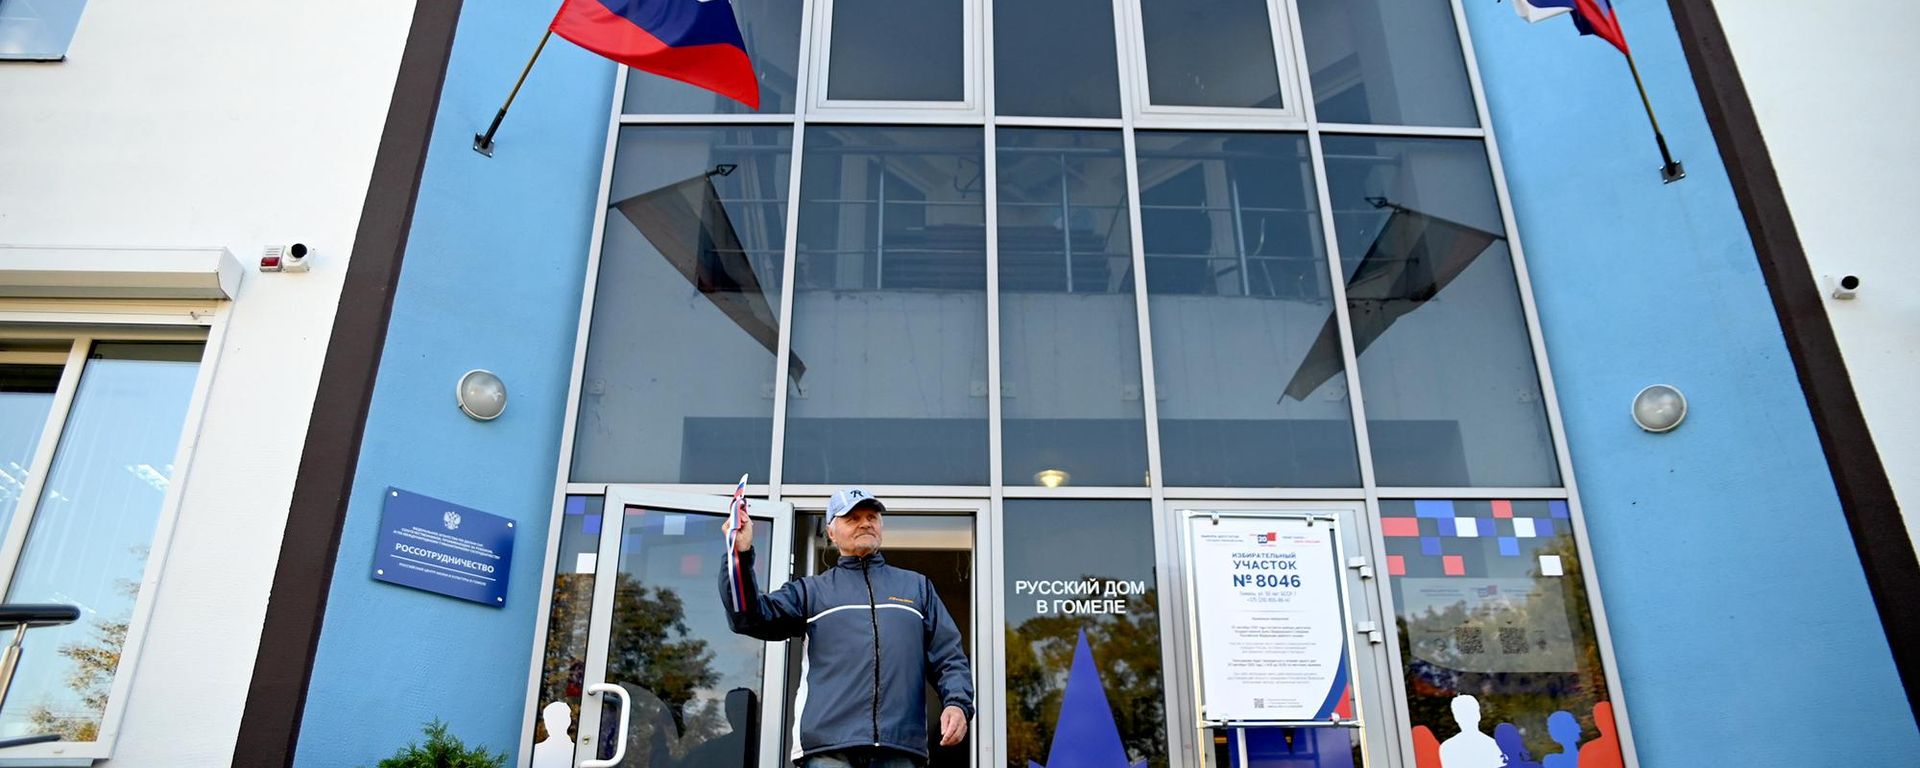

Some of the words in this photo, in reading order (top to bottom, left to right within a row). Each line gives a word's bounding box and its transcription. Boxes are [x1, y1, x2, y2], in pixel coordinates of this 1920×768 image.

[395, 542, 495, 574] РОССОТРУДНИЧЕСТВО
[1233, 560, 1297, 570] УЧАСТОК
[1015, 578, 1100, 595] РУССКИЙ
[1104, 580, 1145, 597] ДОМ
[1256, 574, 1301, 588] 8046
[1036, 599, 1049, 614] В
[1053, 599, 1127, 614] ГОМЕЛЕ
